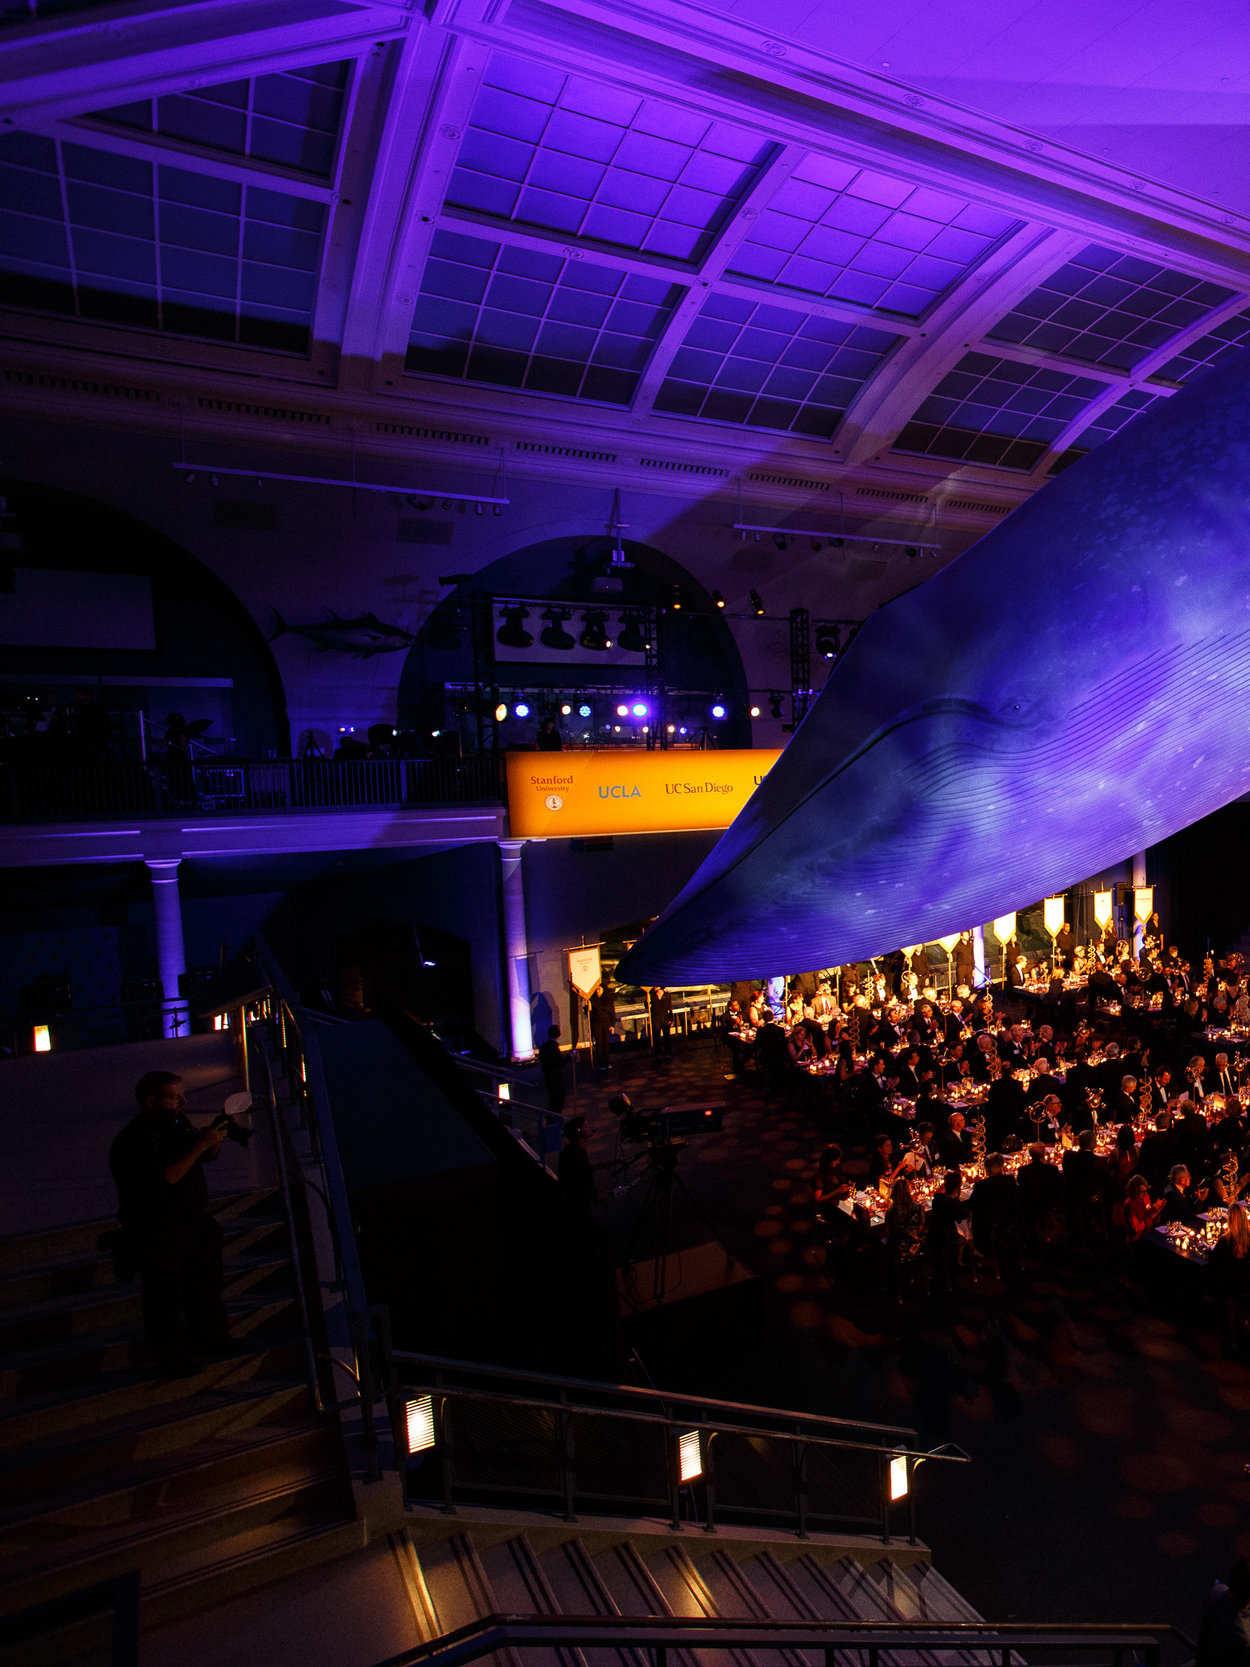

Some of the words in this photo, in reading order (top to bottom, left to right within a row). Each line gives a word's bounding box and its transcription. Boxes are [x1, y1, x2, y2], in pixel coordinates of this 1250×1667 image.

[530, 775, 573, 784] Stanford
[598, 785, 641, 798] UCLA
[665, 783, 682, 794] UC
[683, 782, 704, 794] San
[705, 782, 733, 794] Diego
